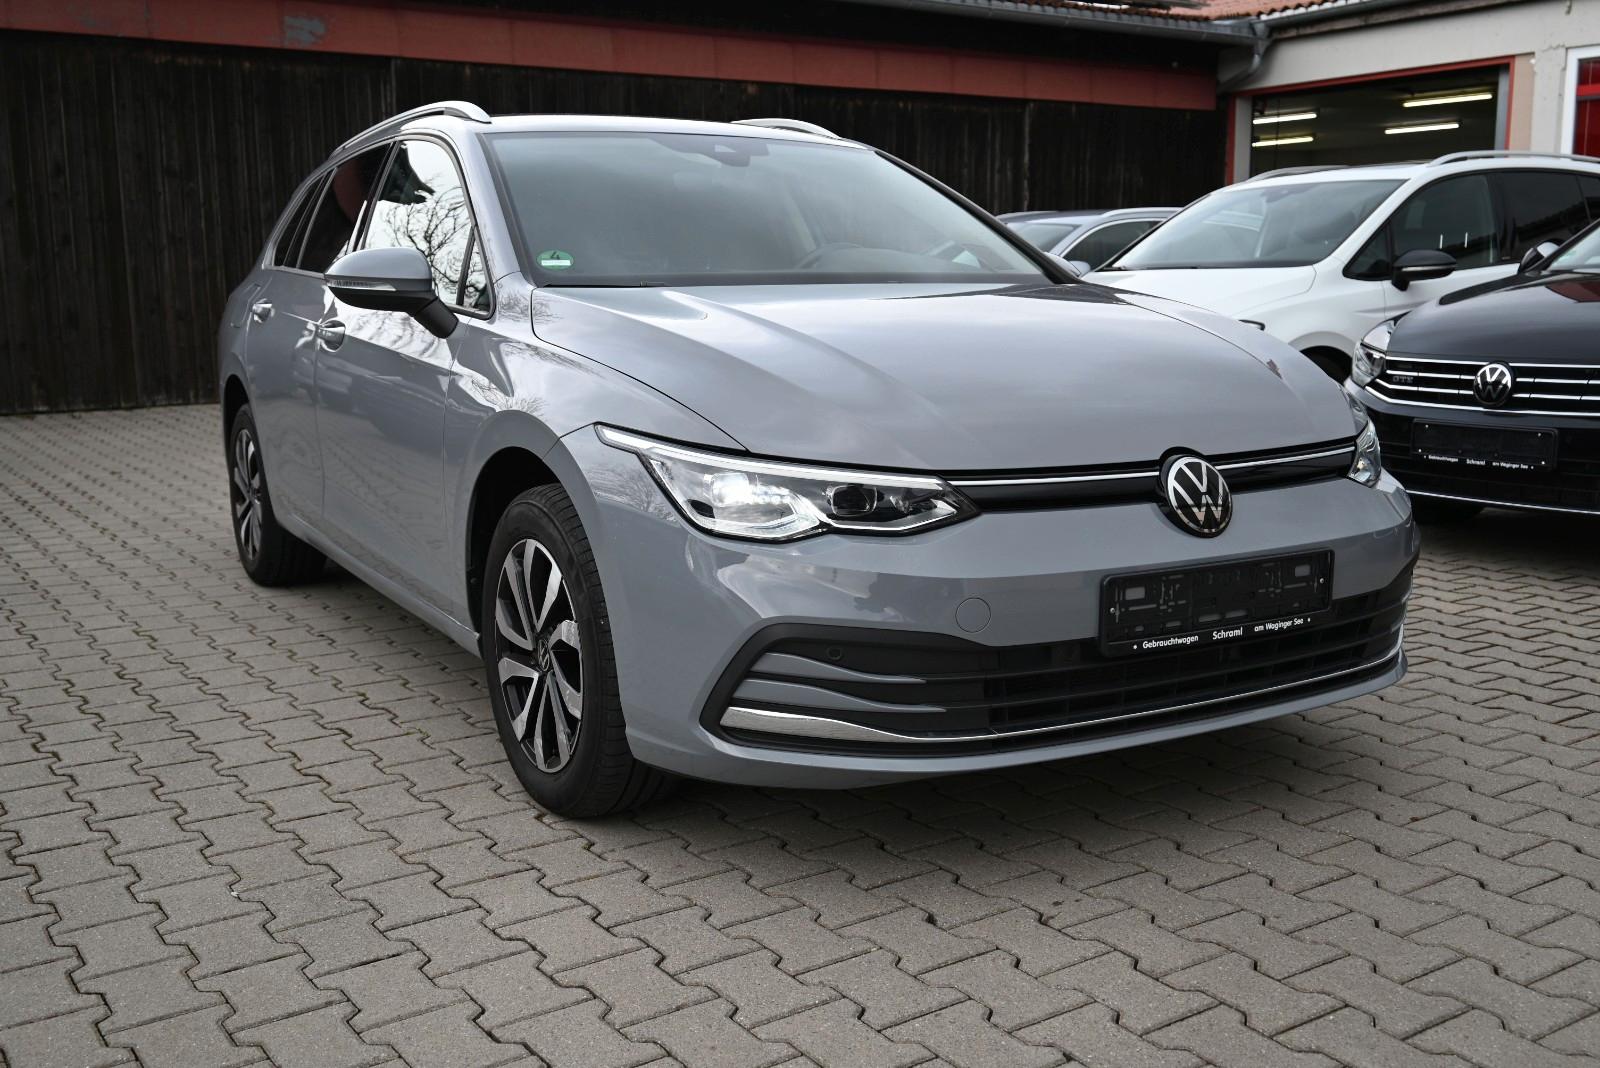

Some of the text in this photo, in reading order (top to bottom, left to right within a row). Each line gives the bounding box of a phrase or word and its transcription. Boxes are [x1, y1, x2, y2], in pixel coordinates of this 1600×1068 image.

[1475, 363, 1511, 405] VW
[1168, 456, 1230, 532] VW
[1142, 635, 1199, 649] Gebrauchtwagen
[1212, 627, 1243, 640] Schraml
[1265, 620, 1293, 631] Waginger
[1293, 617, 1304, 626] See
